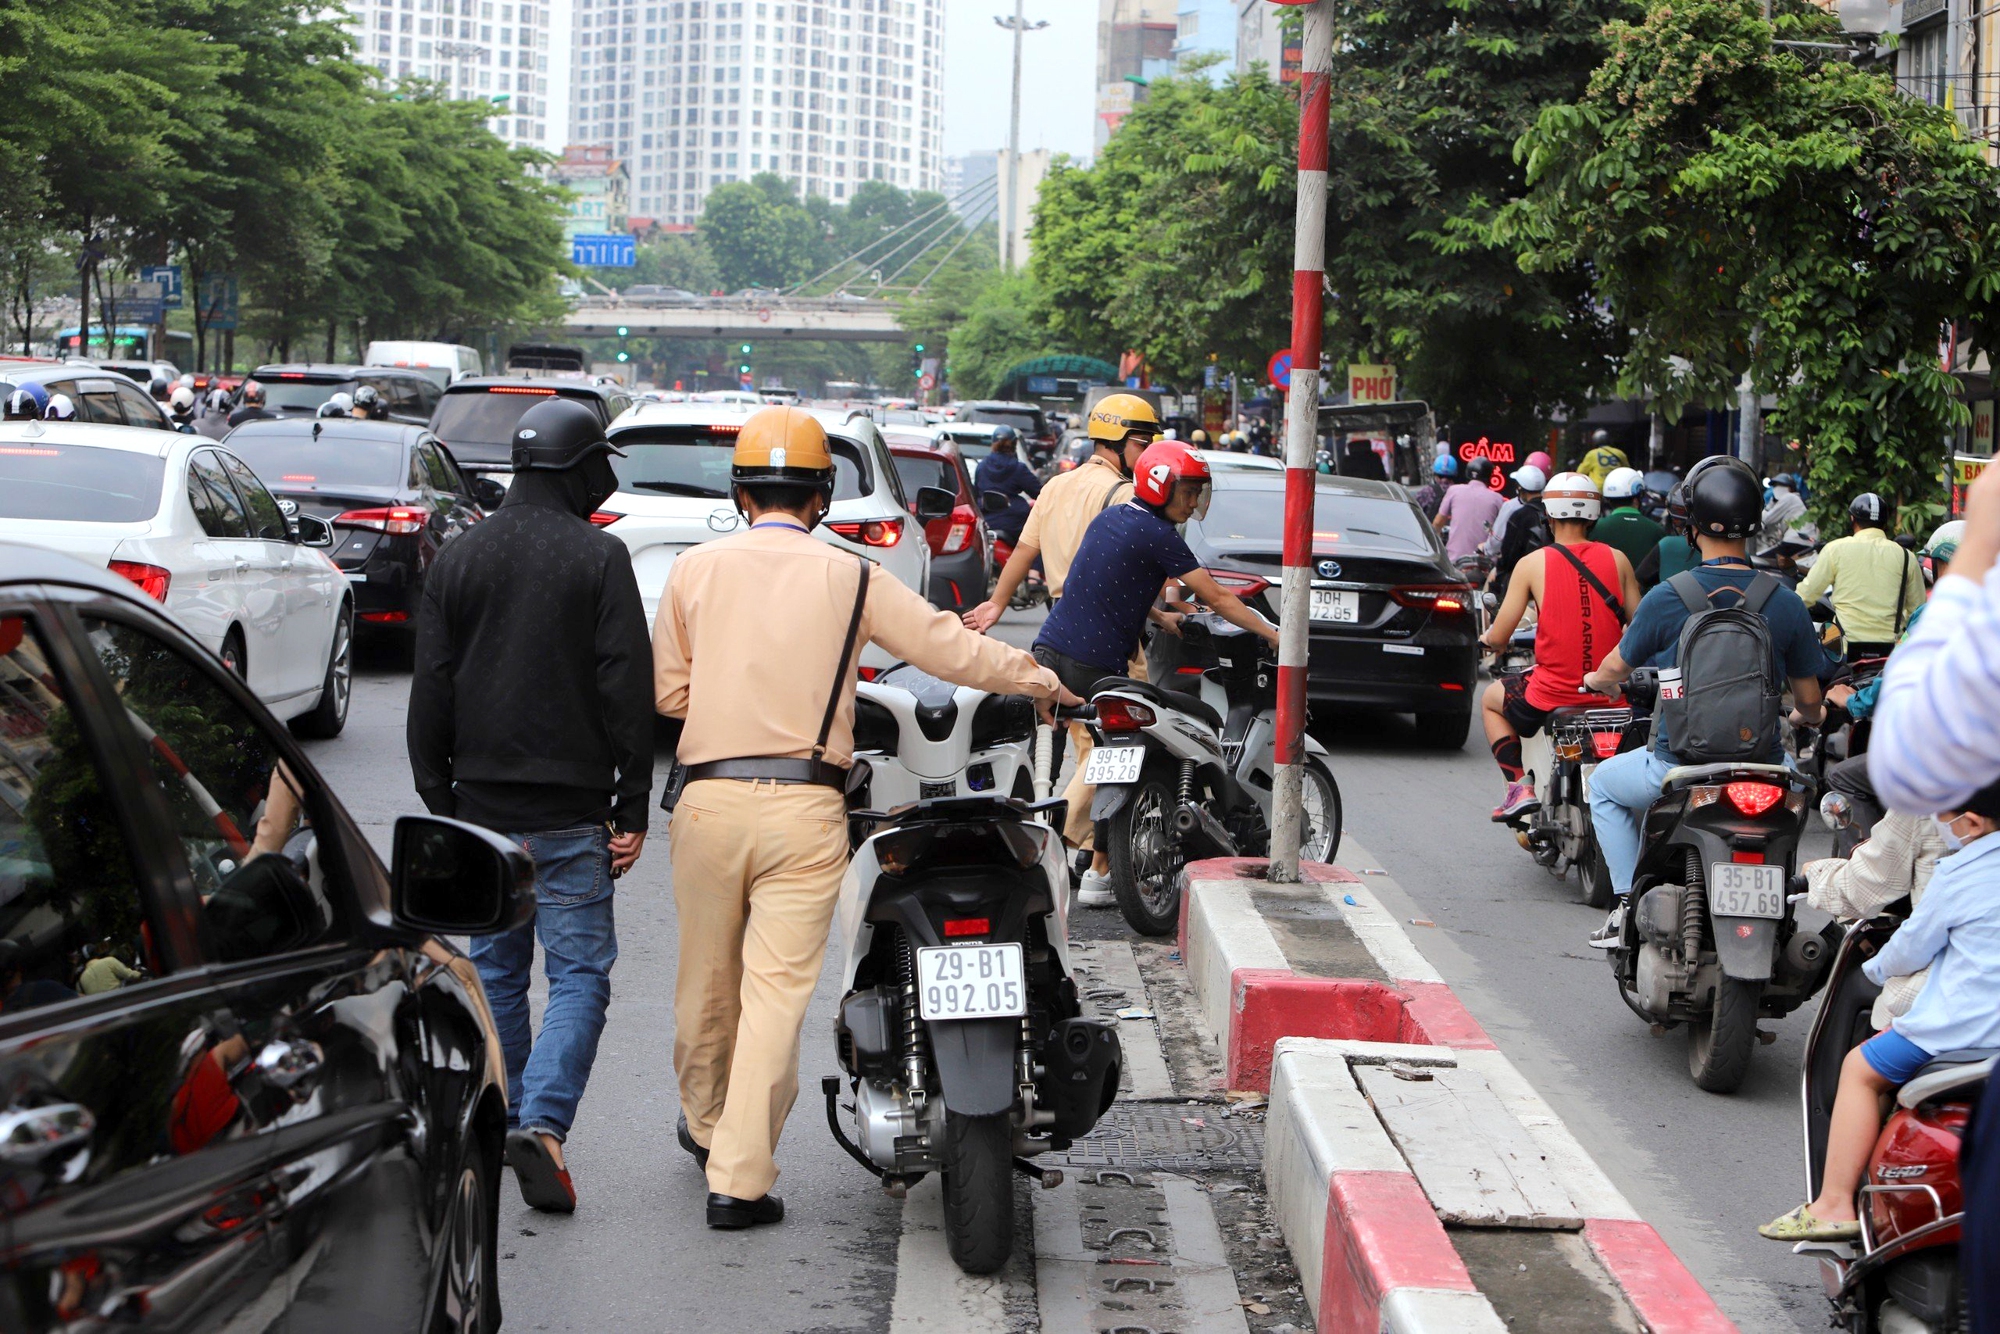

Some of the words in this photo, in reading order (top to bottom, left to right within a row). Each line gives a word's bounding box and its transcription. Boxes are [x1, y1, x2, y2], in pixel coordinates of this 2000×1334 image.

[1352, 367, 1393, 400] PHỞ
[1092, 412, 1121, 425] CSGT
[1315, 591, 1341, 604] 30H
[1578, 561, 1591, 618] NDER
[1309, 605, 1351, 621] 72.85
[1086, 764, 1137, 781] 395.26
[1723, 867, 1773, 890] 35-B1
[1716, 890, 1780, 915] 457.69
[934, 949, 1006, 981] 29-B1
[927, 981, 1018, 1014] 992.05
[1876, 1164, 1928, 1179] LEAD
